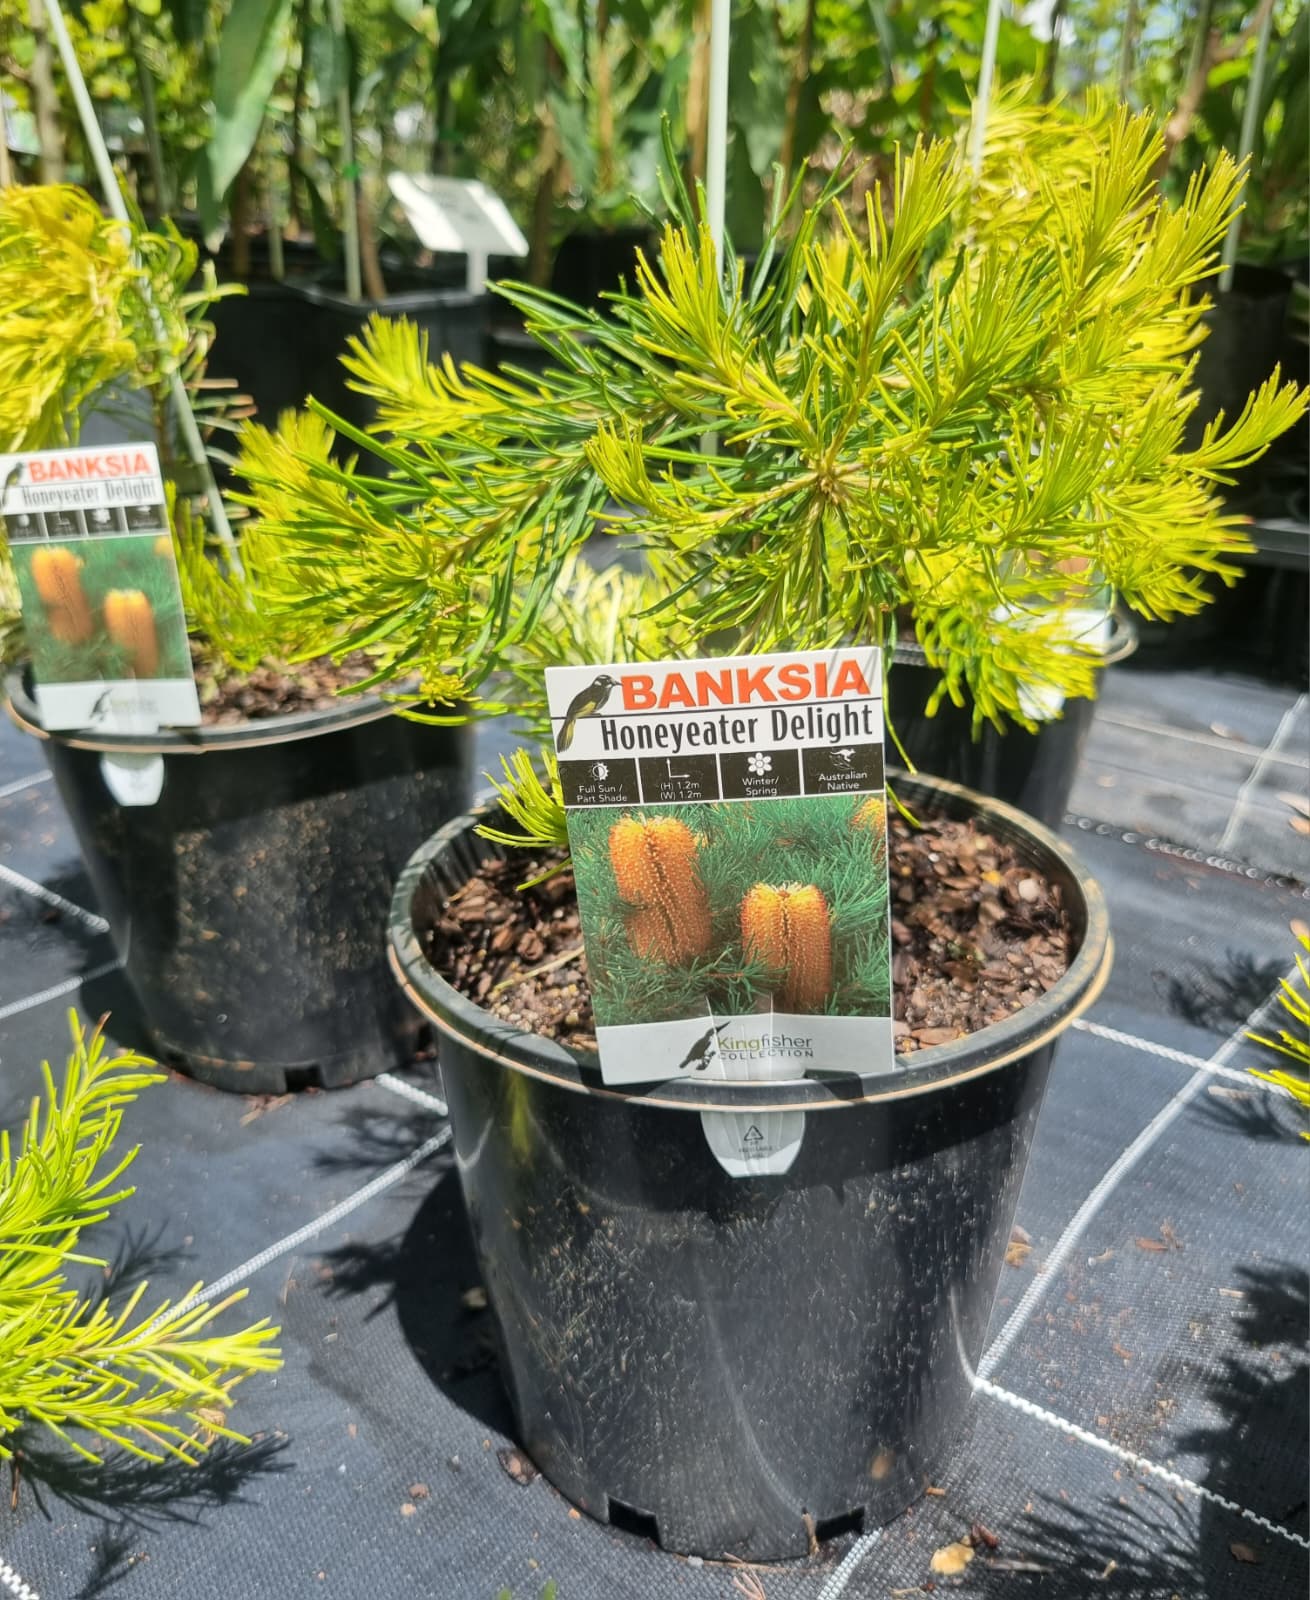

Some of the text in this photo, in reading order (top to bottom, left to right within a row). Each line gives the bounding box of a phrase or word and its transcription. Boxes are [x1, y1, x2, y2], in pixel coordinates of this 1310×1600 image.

[28, 452, 153, 483] BANKSIA
[22, 478, 157, 508] Honeyeater Delight
[620, 659, 871, 711] BANKSIA
[600, 704, 873, 753] Honeyeater Delight
[741, 776, 779, 787] Winter/
[818, 771, 868, 782] Australian
[579, 785, 596, 793] Full
[599, 784, 616, 793] Sun
[660, 781, 700, 791] (H) 1.2m
[745, 786, 778, 797] Spring
[827, 781, 860, 791] Native
[576, 793, 627, 803] Part Shade
[660, 790, 702, 800] (W) 1.2m
[718, 1033, 813, 1051] Kingfisher
[717, 1049, 814, 1060] COLLECTION
